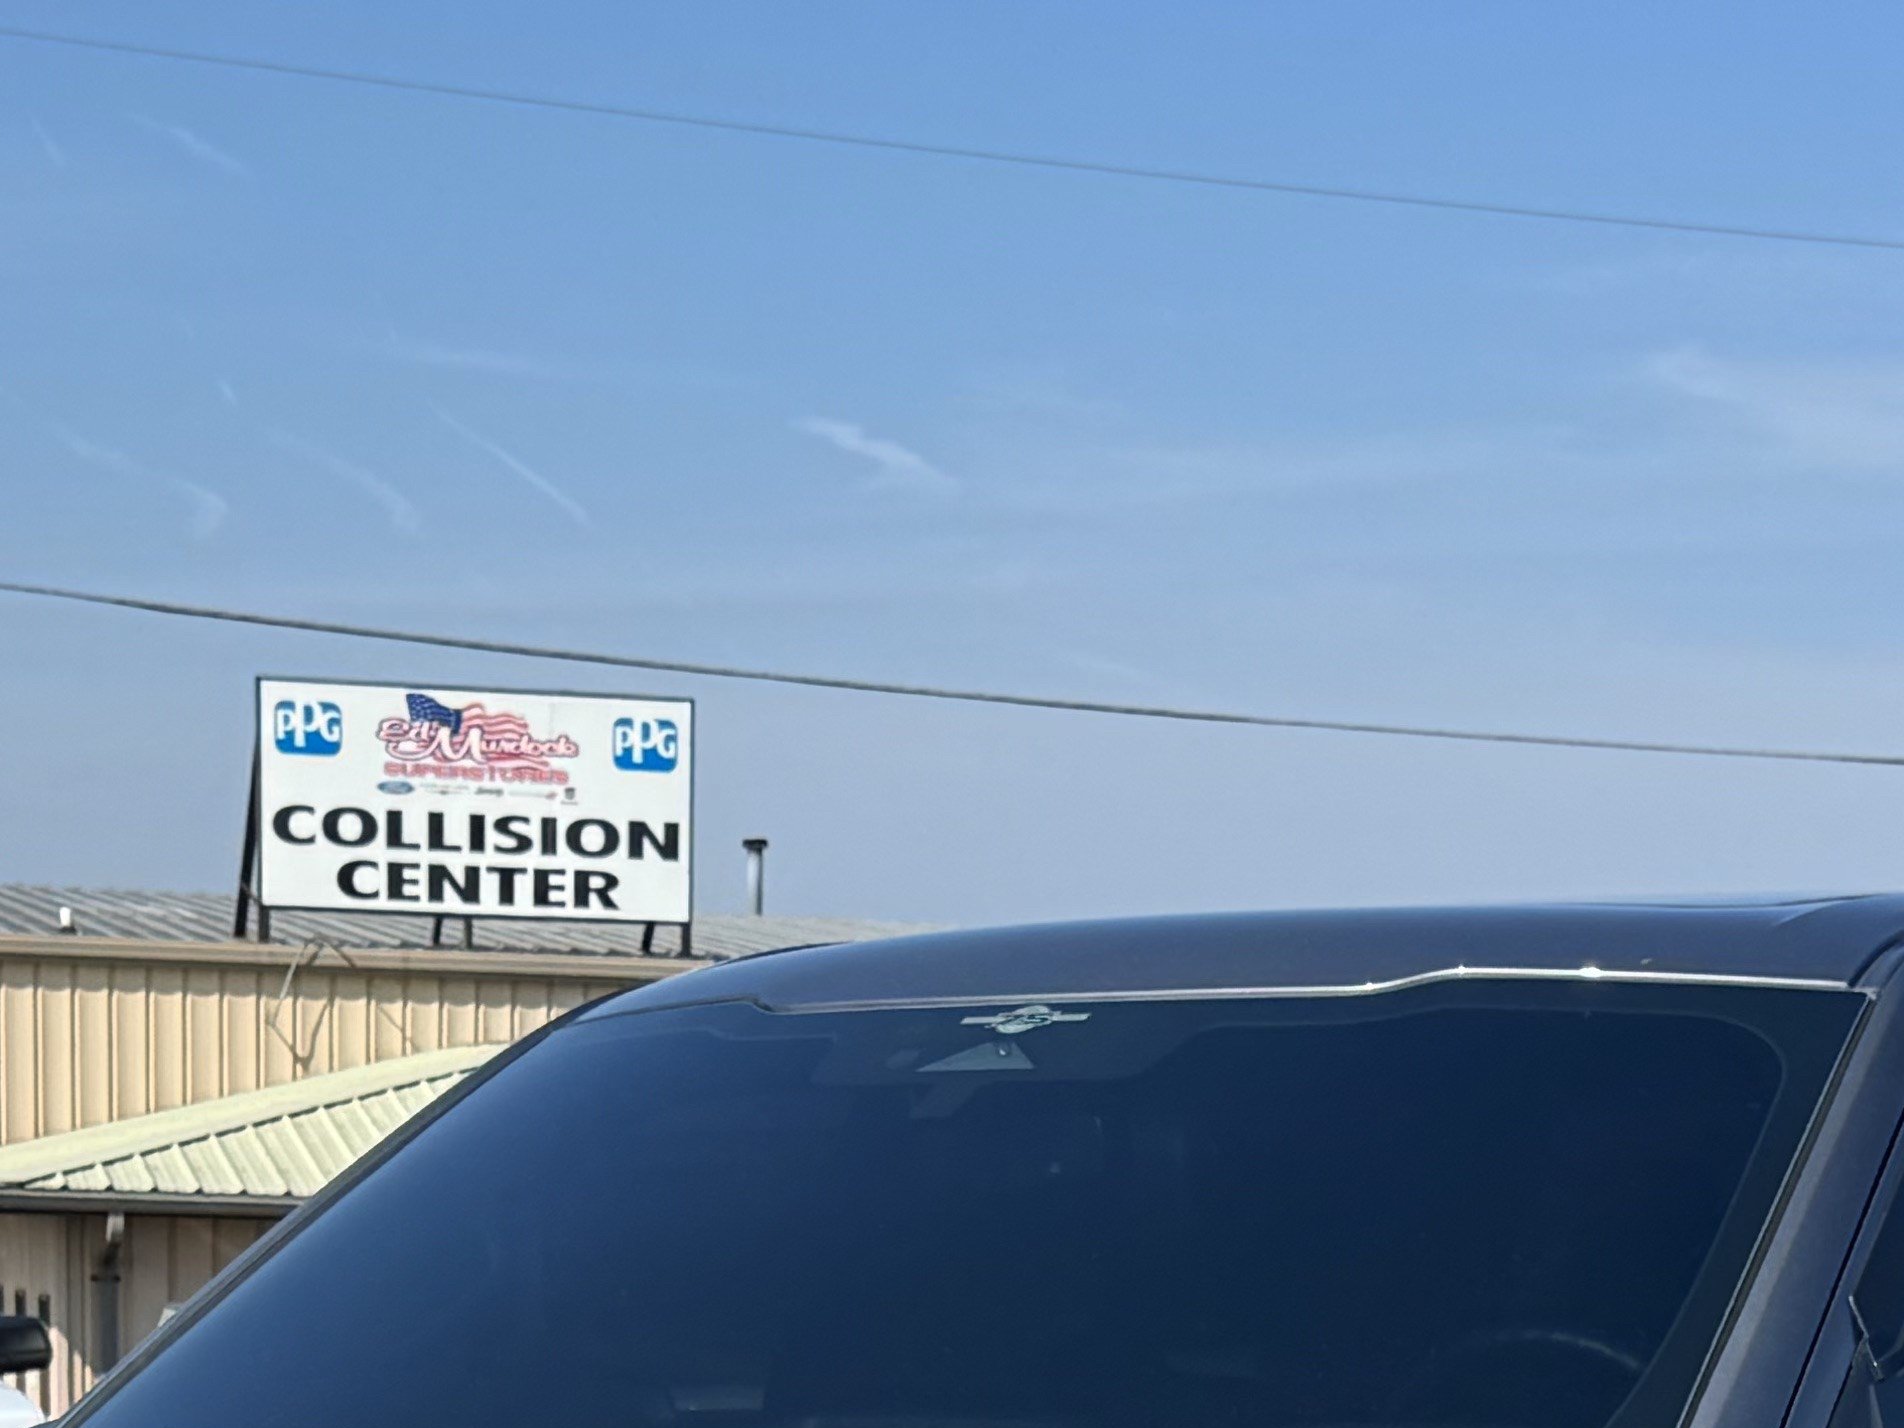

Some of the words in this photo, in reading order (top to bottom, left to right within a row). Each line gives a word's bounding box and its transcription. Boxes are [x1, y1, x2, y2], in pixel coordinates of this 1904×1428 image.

[276, 699, 341, 748] PPG
[614, 716, 676, 764] PPG
[272, 804, 680, 862] COLLISION
[336, 860, 621, 911] CENTER
